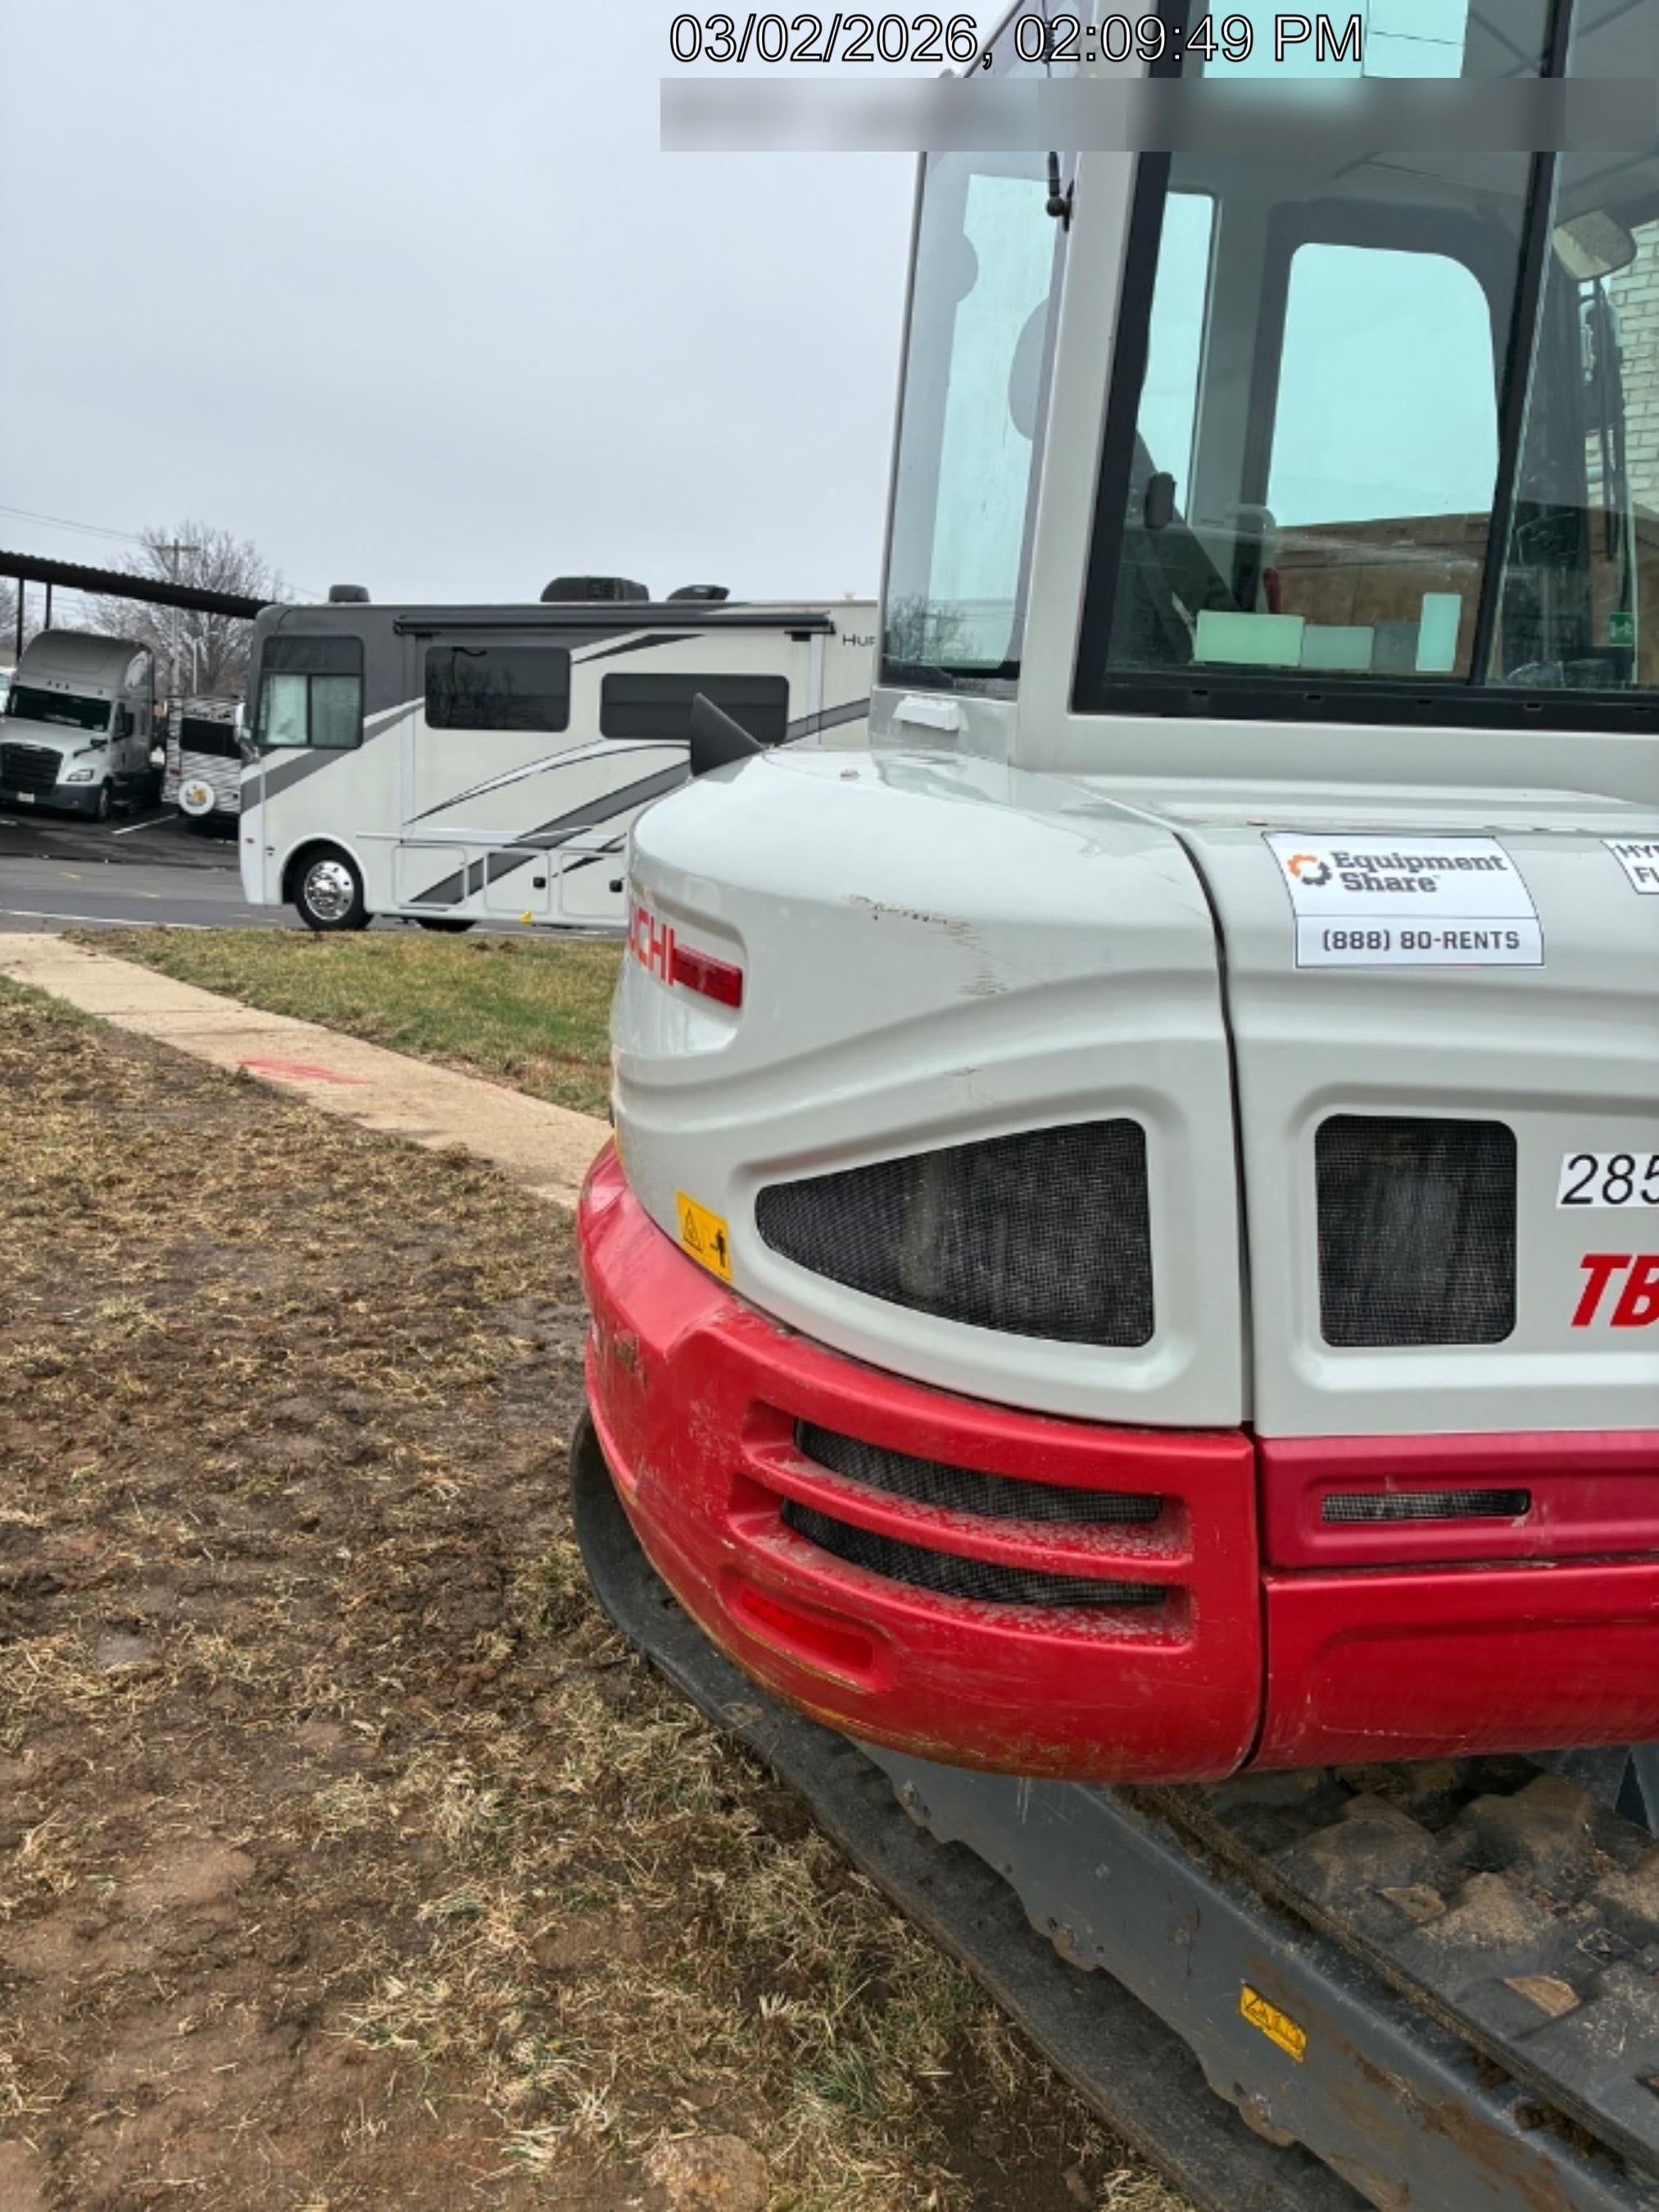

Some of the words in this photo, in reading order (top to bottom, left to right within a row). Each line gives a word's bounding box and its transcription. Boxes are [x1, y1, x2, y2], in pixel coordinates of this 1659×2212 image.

[1330, 850, 1508, 873] Equipment
[1339, 872, 1439, 893] Share
[1322, 928, 1391, 952] (888)
[1400, 930, 1521, 950] 80-RENTS
[1571, 1254, 1659, 1328] TB
